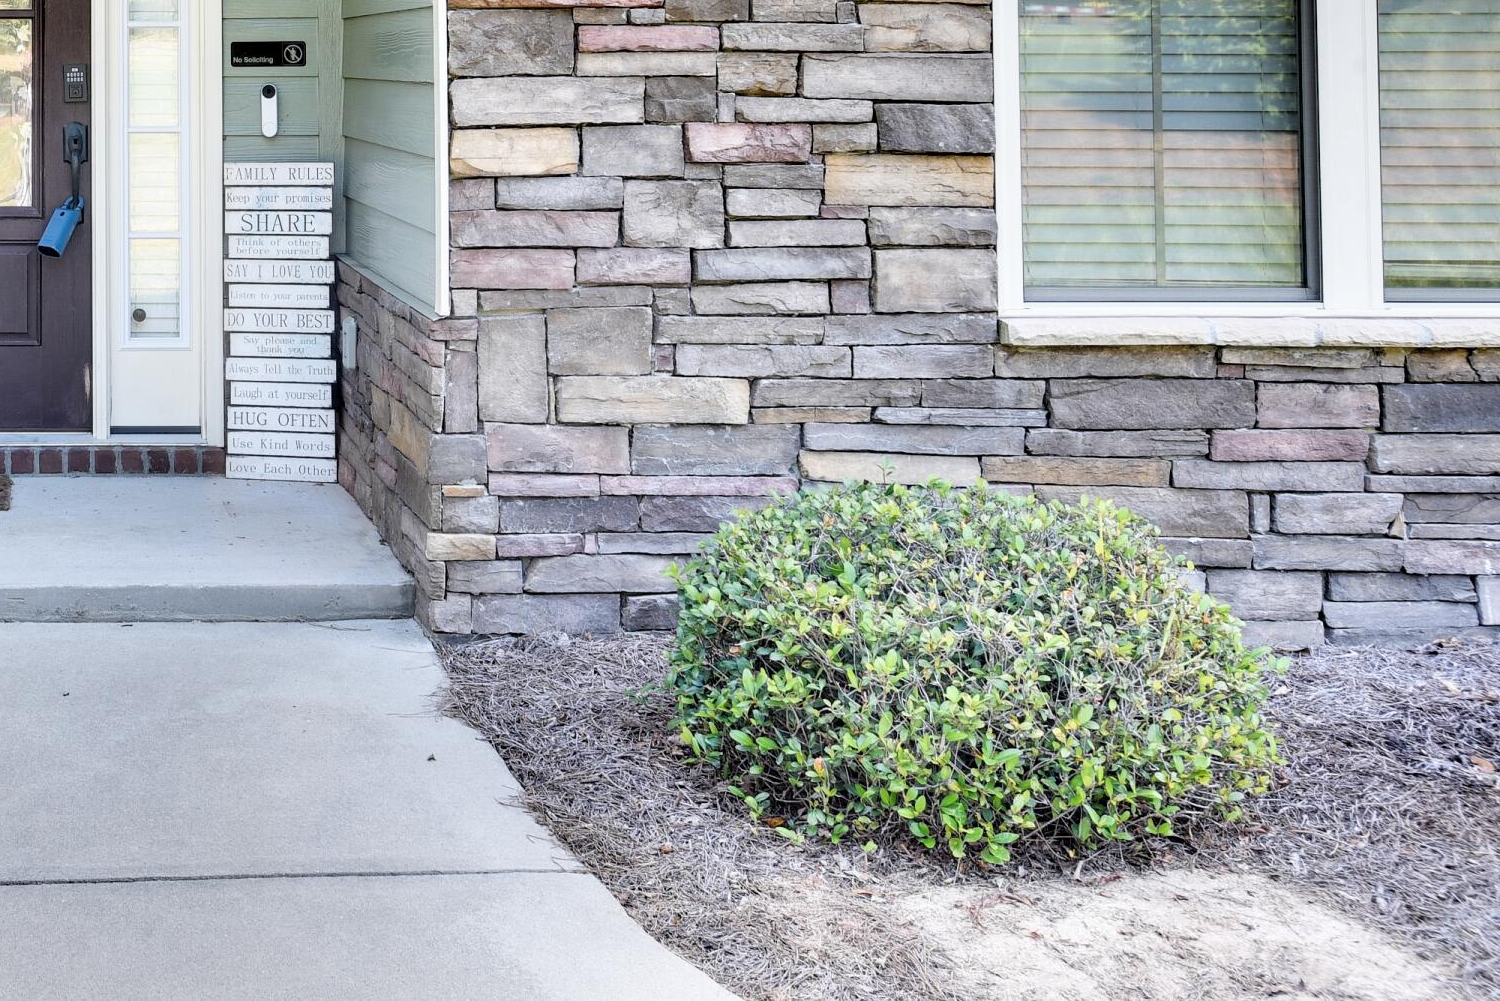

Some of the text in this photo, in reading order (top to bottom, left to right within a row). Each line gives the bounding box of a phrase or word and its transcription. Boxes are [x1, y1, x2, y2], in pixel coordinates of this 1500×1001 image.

[244, 56, 274, 64] Soliciting
[226, 167, 333, 180] FAMILY RULES
[227, 192, 332, 204] Keep your promises
[241, 214, 316, 233] SHARE
[237, 238, 322, 247] Think of others
[236, 245, 321, 256] before yourself
[227, 263, 333, 280] SAY I LOVE YOU
[230, 290, 329, 302] Listen to your parents
[227, 312, 331, 329] DO YOUR BEST
[243, 336, 317, 347] Say please and
[257, 345, 305, 356] thank you
[228, 363, 333, 376] Always Tell the Truth
[234, 386, 328, 401] Laugh at yourself
[233, 411, 329, 428] HUG OFTEN
[232, 437, 330, 452] Use Kind Words
[229, 461, 334, 476] Love Each Other
